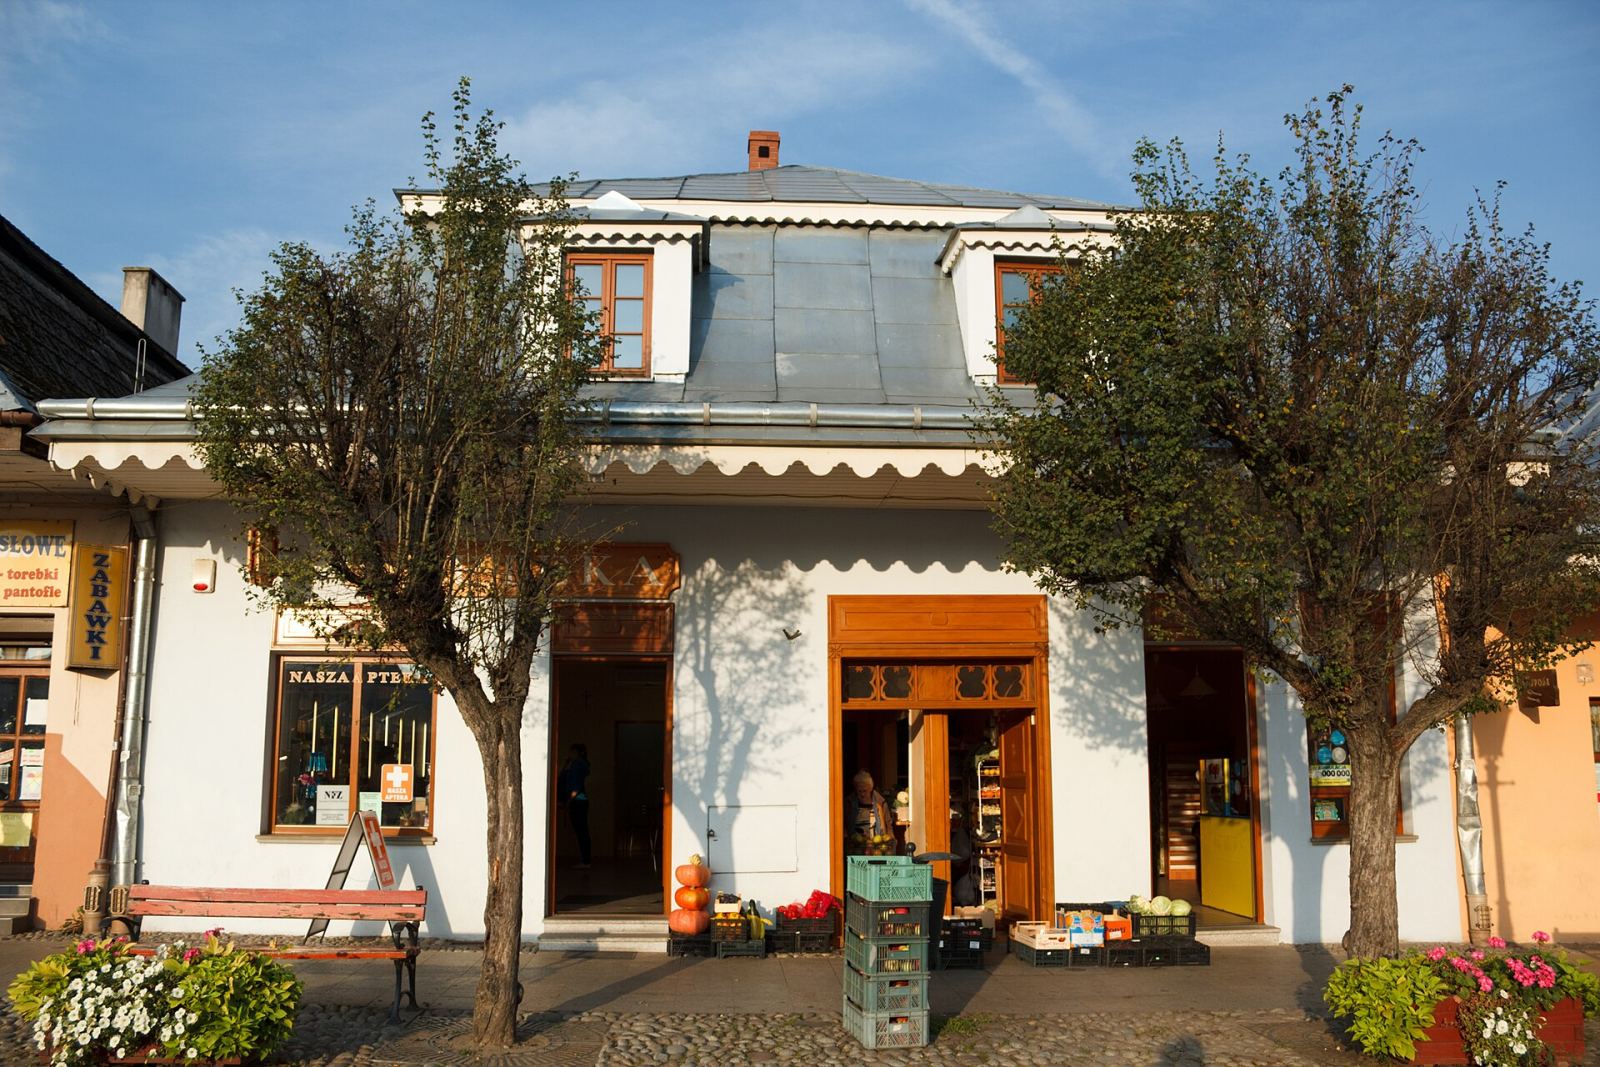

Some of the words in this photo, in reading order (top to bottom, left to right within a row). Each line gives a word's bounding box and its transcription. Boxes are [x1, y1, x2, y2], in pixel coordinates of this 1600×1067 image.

[7, 568, 59, 580] torebki
[3, 586, 62, 600] pantofle
[84, 553, 112, 660] ZABAWKI
[289, 671, 350, 683] NASZA
